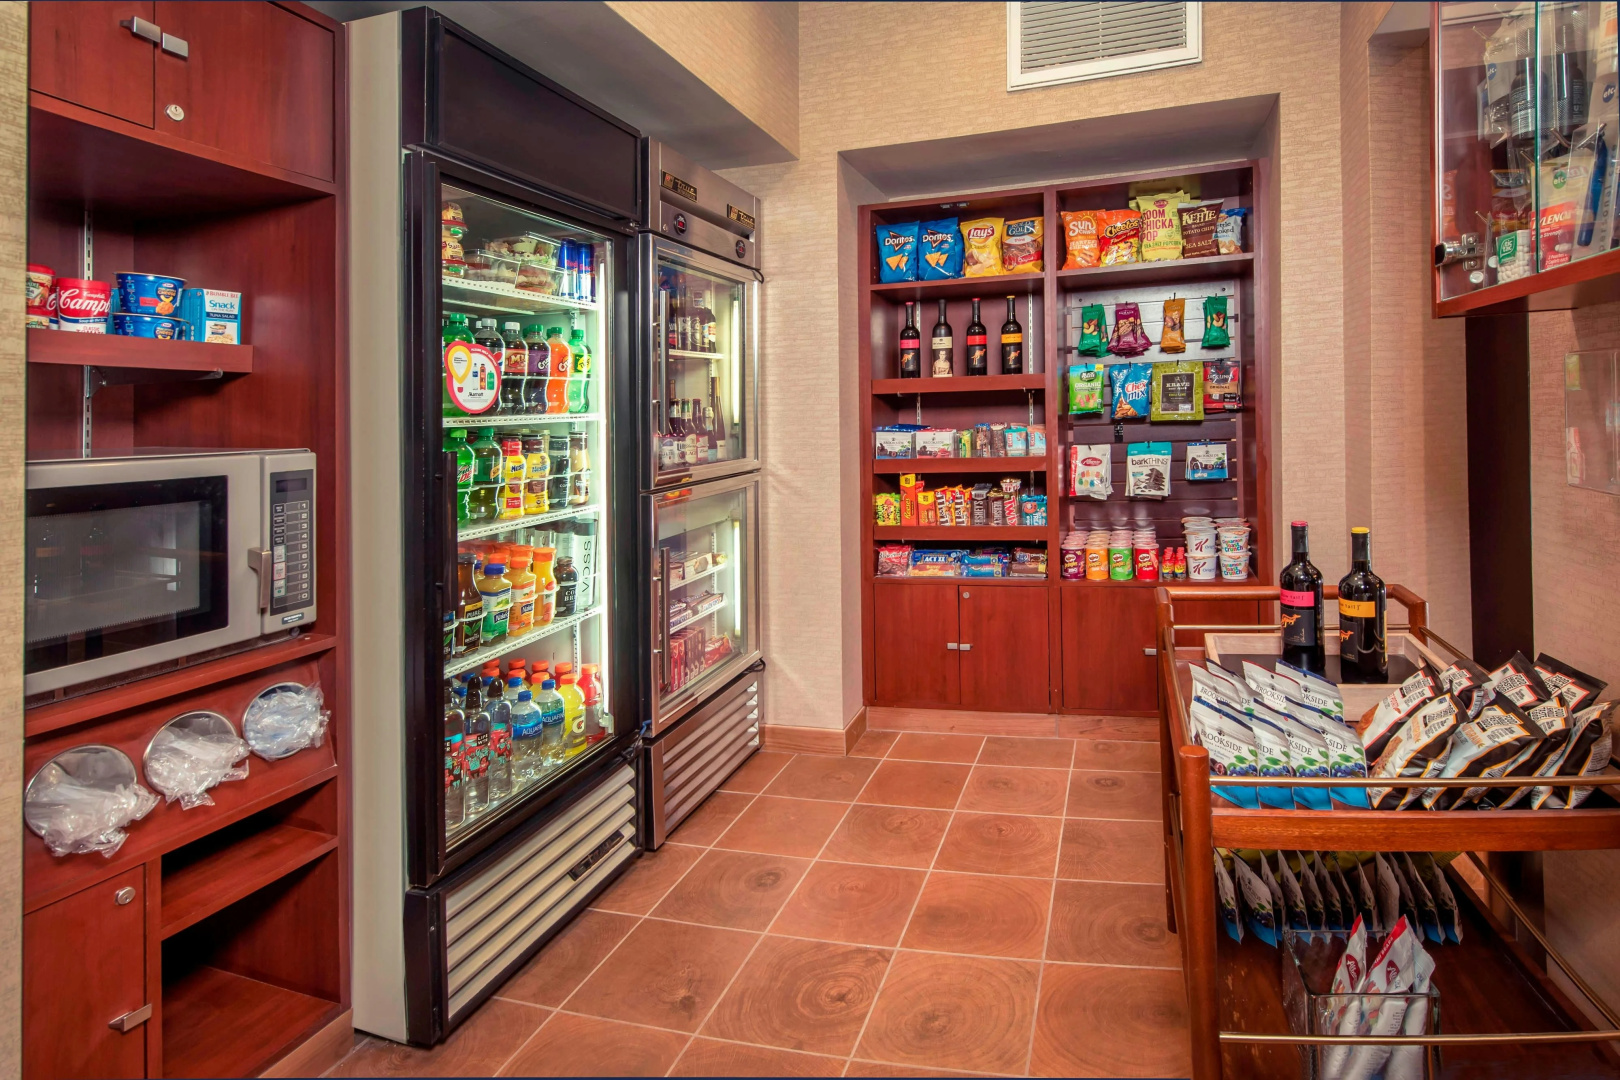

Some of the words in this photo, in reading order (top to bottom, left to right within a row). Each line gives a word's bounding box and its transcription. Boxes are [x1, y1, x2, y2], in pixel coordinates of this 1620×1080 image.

[1008, 225, 1034, 236] GOLD
[1069, 220, 1096, 236] Sun
[1105, 219, 1140, 237] Cheetos
[884, 235, 914, 246] Doritos
[922, 233, 952, 243] Doritos
[209, 299, 235, 309] Snack
[1125, 380, 1148, 393] Chex
[1128, 391, 1147, 401] mix
[1131, 457, 1168, 466] barkTHINS
[1195, 538, 1209, 553] K
[1224, 545, 1244, 553] Crunch
[582, 540, 592, 593] VOSS
[1193, 562, 1207, 575] K
[1200, 728, 1243, 754] BROOKSIDE
